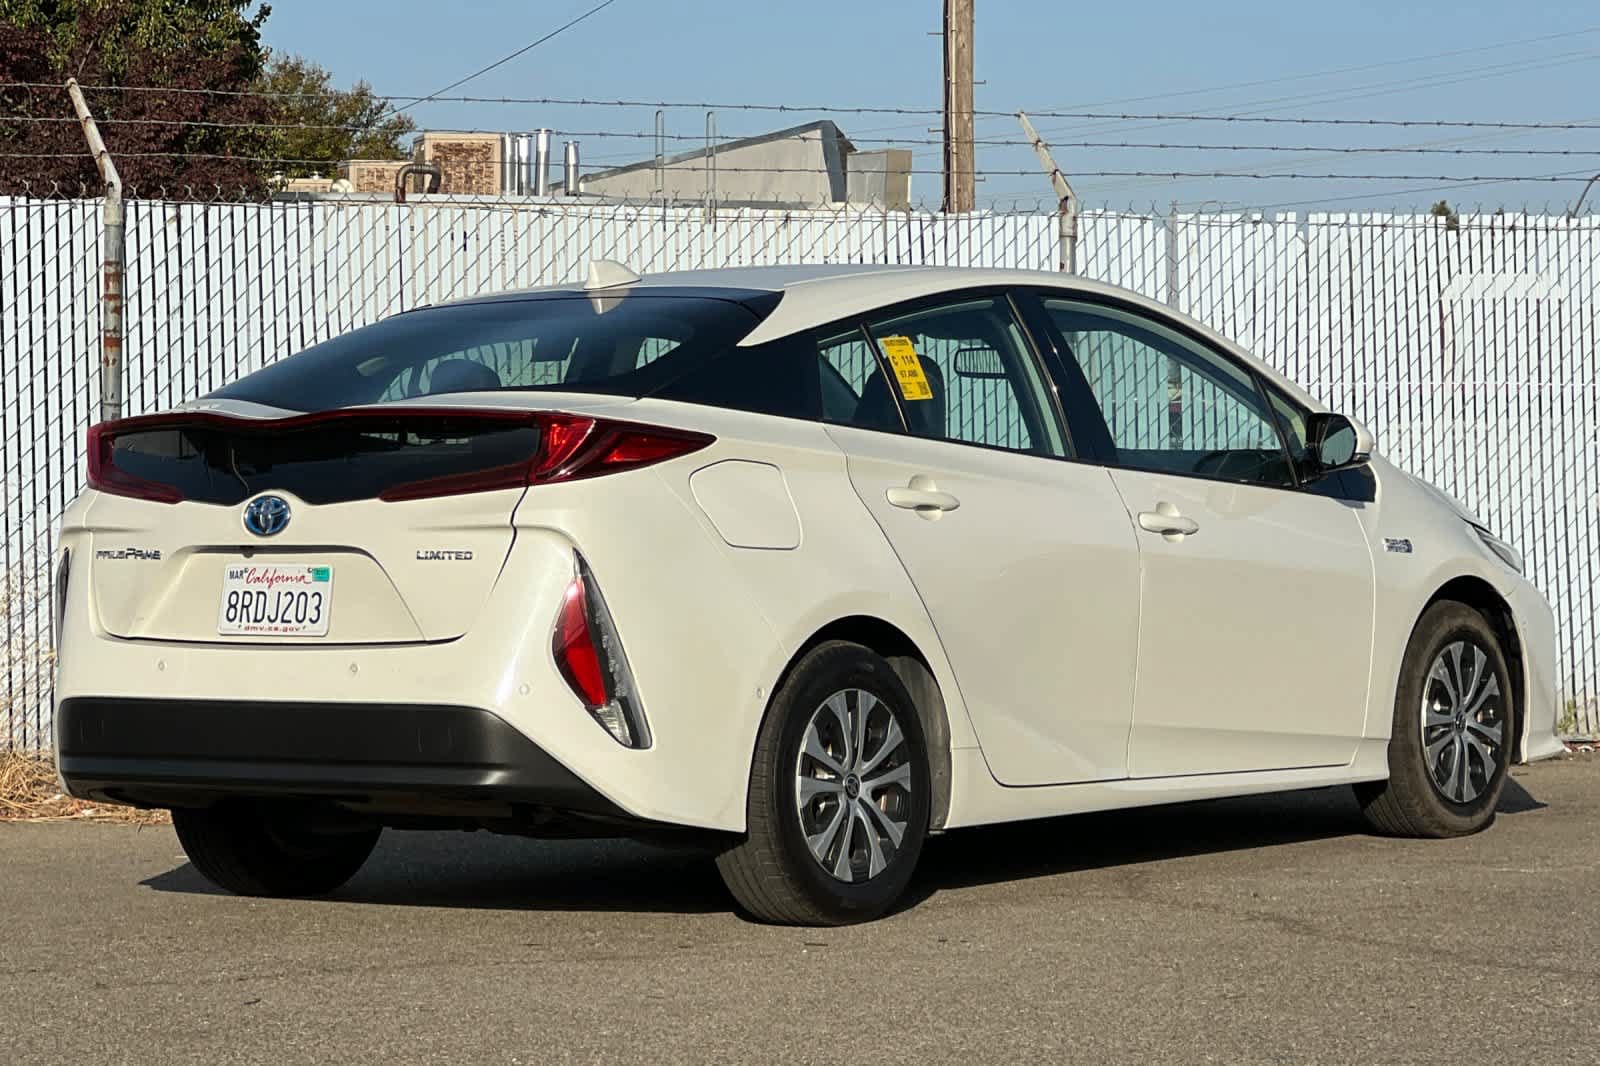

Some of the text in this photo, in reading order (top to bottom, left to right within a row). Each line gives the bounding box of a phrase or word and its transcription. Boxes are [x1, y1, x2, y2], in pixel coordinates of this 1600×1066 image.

[416, 551, 473, 560] LIMITED
[229, 570, 244, 579] MAR
[246, 567, 312, 589] California
[226, 590, 323, 624] 8RDJ203
